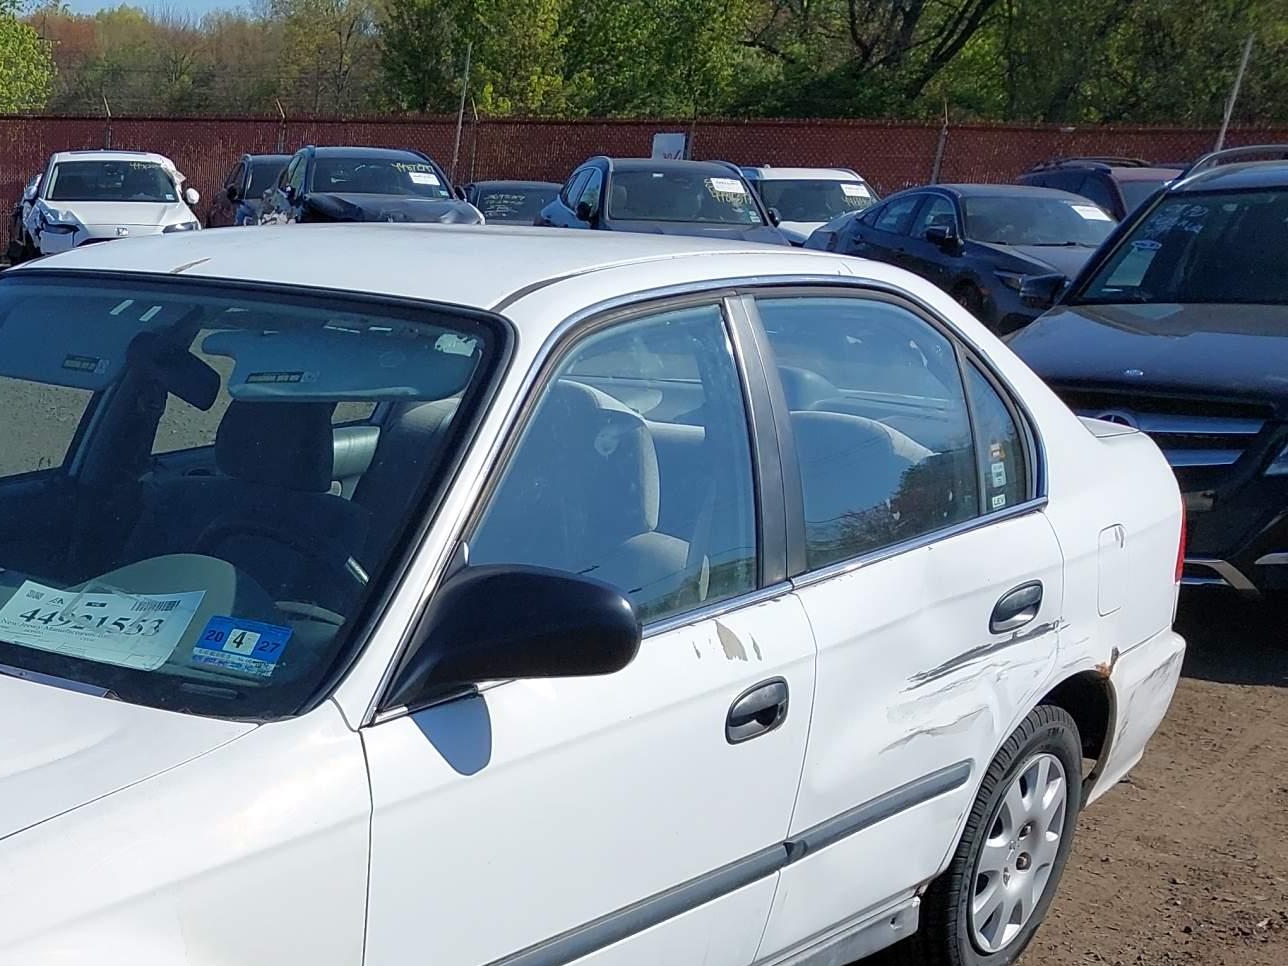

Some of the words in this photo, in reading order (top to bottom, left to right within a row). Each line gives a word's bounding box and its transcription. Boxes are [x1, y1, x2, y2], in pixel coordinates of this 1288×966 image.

[994, 495, 1005, 506] LEV
[205, 630, 224, 642] 20
[232, 632, 247, 648] 4
[259, 641, 280, 653] 27
